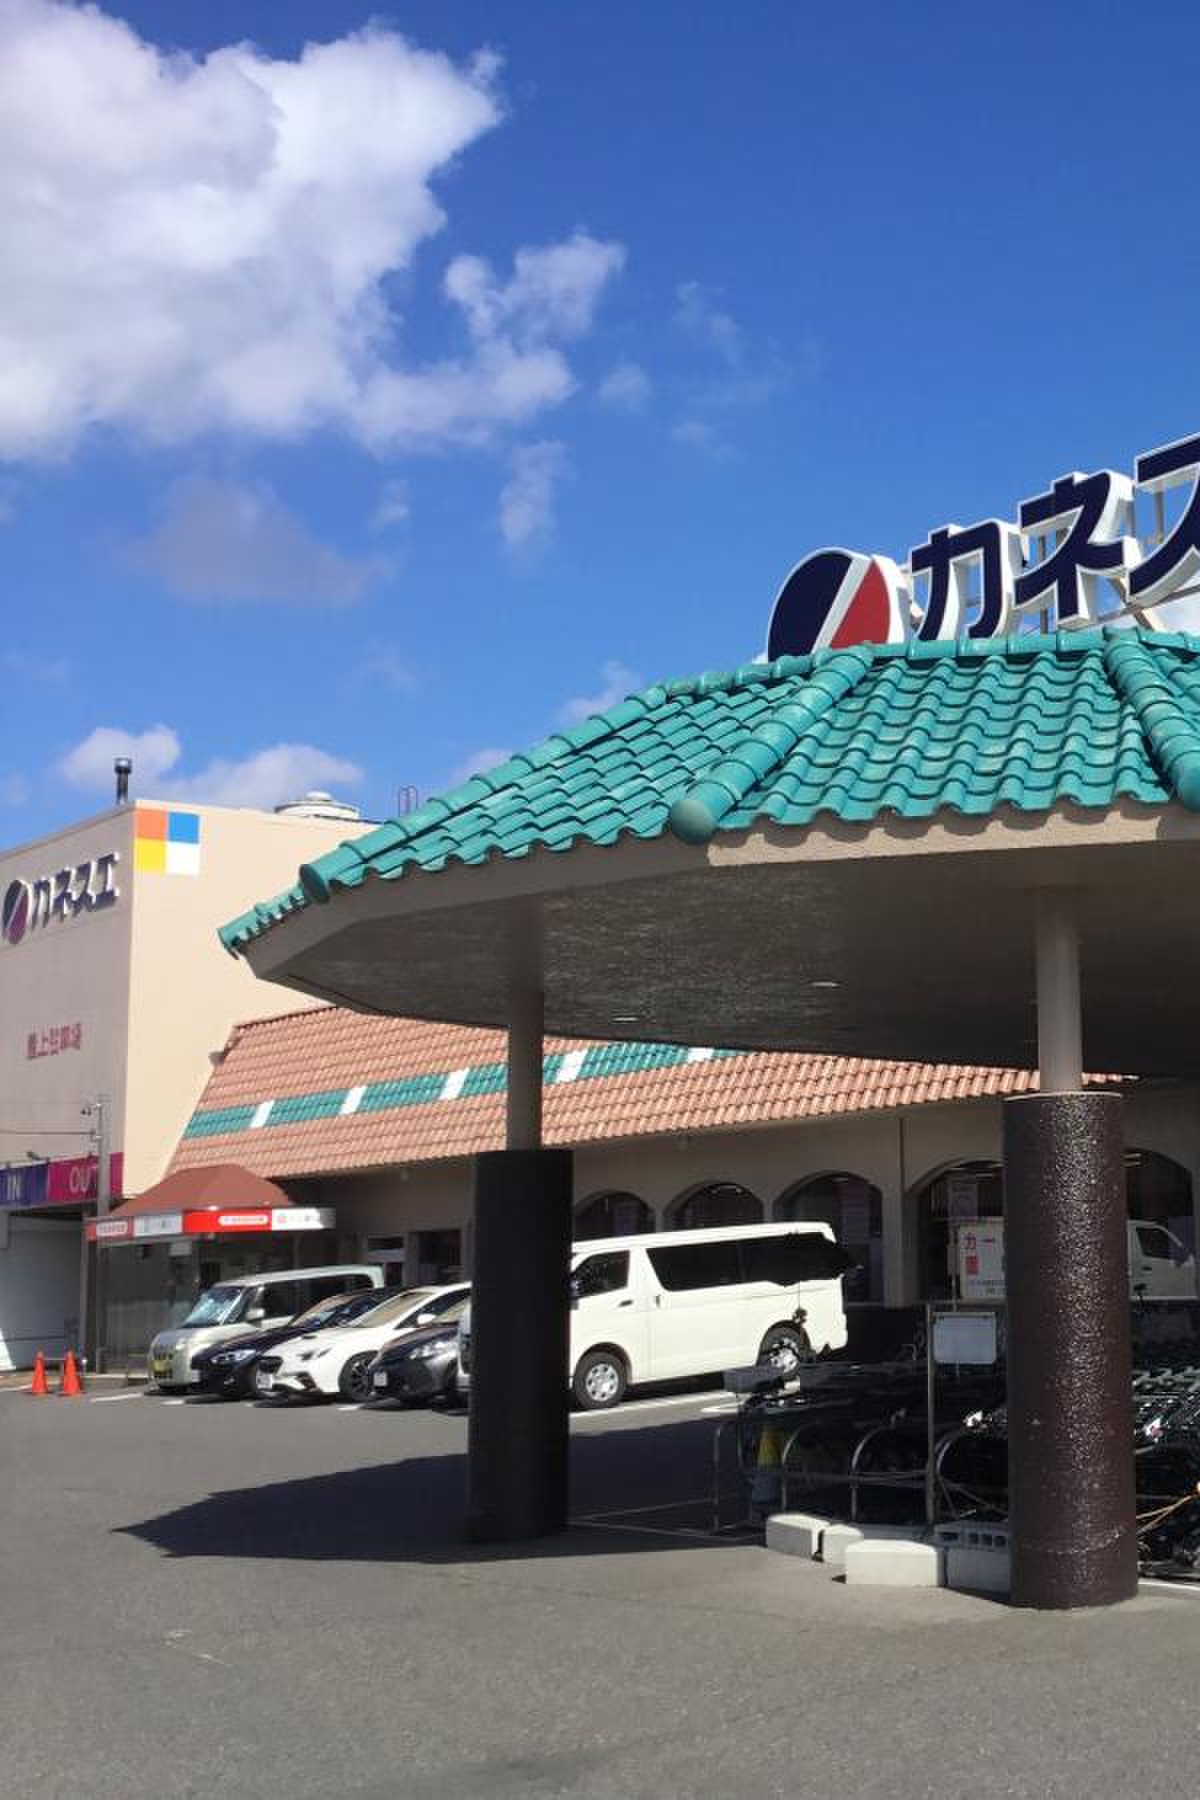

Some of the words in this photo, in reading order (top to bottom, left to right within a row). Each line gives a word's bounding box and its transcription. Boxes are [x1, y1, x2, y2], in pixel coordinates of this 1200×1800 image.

[31, 851, 119, 926] カネスエ
[7, 1173, 21, 1202] IN
